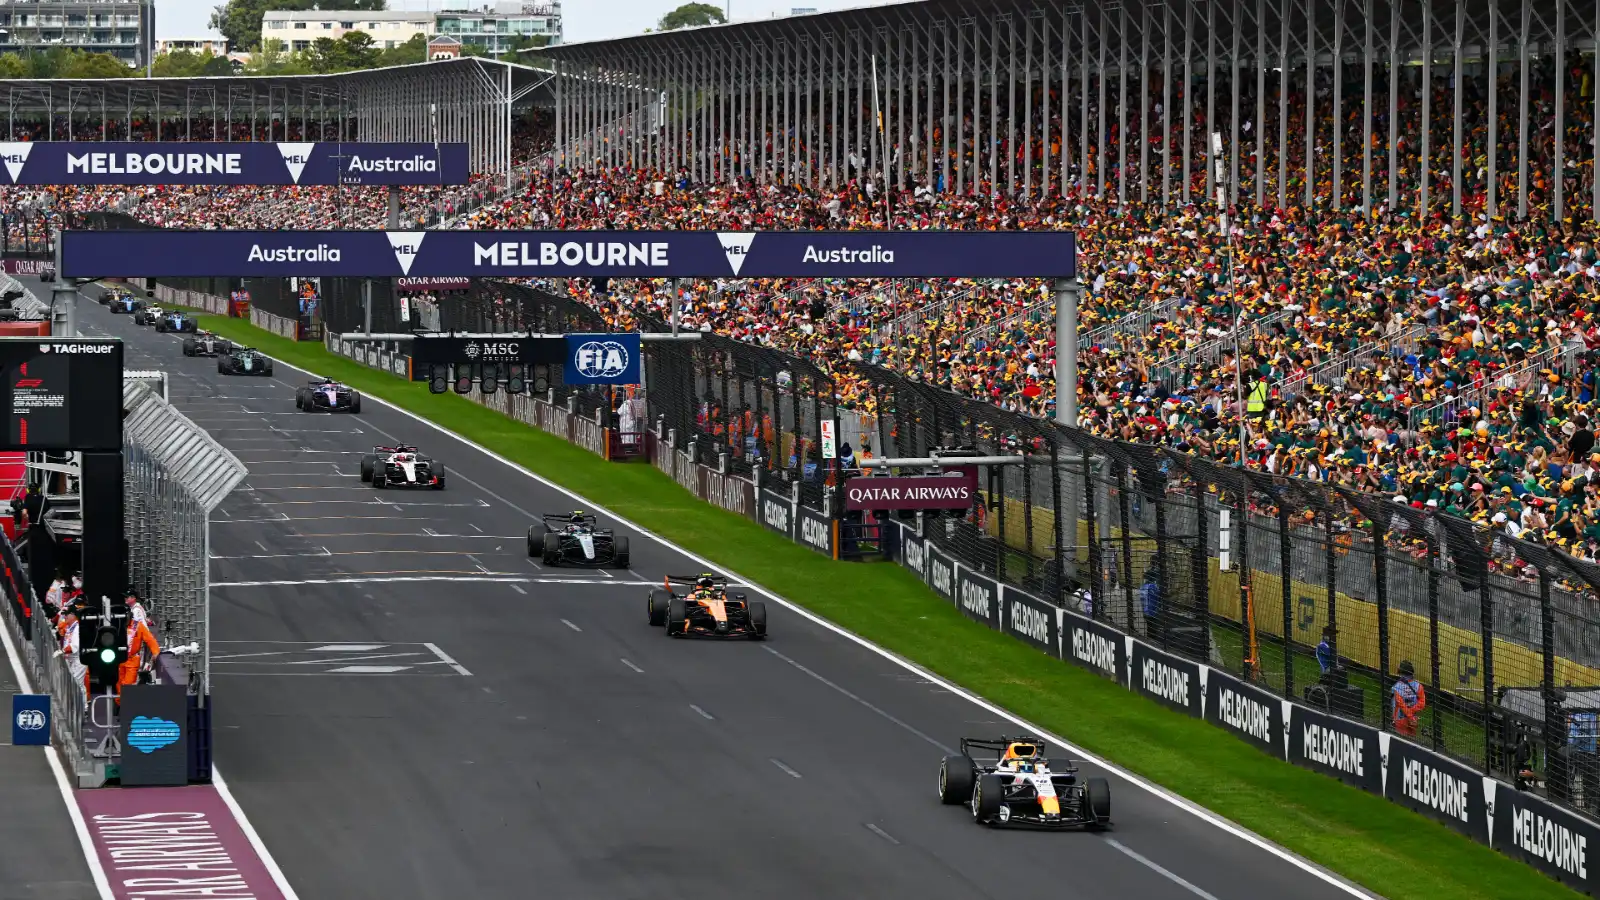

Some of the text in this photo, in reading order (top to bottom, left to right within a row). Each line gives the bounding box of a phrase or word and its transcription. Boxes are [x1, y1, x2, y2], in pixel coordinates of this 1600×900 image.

[67, 153, 241, 174] MELBOURNE
[283, 155, 307, 164] MEL
[348, 155, 436, 172] Australia
[248, 244, 341, 262] Australia
[393, 245, 418, 255] MEL
[474, 242, 669, 266] MELBOURNE
[724, 246, 748, 255] MEL
[802, 245, 894, 263] Australia
[398, 276, 469, 286] QATAR AIRWAYS
[483, 342, 519, 354] MSC
[850, 486, 969, 502] QATAR AIRWAYS
[1011, 601, 1048, 645] MELBOURNE
[1072, 627, 1115, 674] MELBOURNE
[1142, 657, 1189, 707] MELBOURNE
[1219, 686, 1270, 744] MELBOURNE
[1303, 723, 1364, 777] MELBOURNE
[1403, 756, 1468, 823] MELBOURNE
[92, 812, 238, 871] AIRWAYS
[1513, 804, 1587, 880] MELBOURNE
